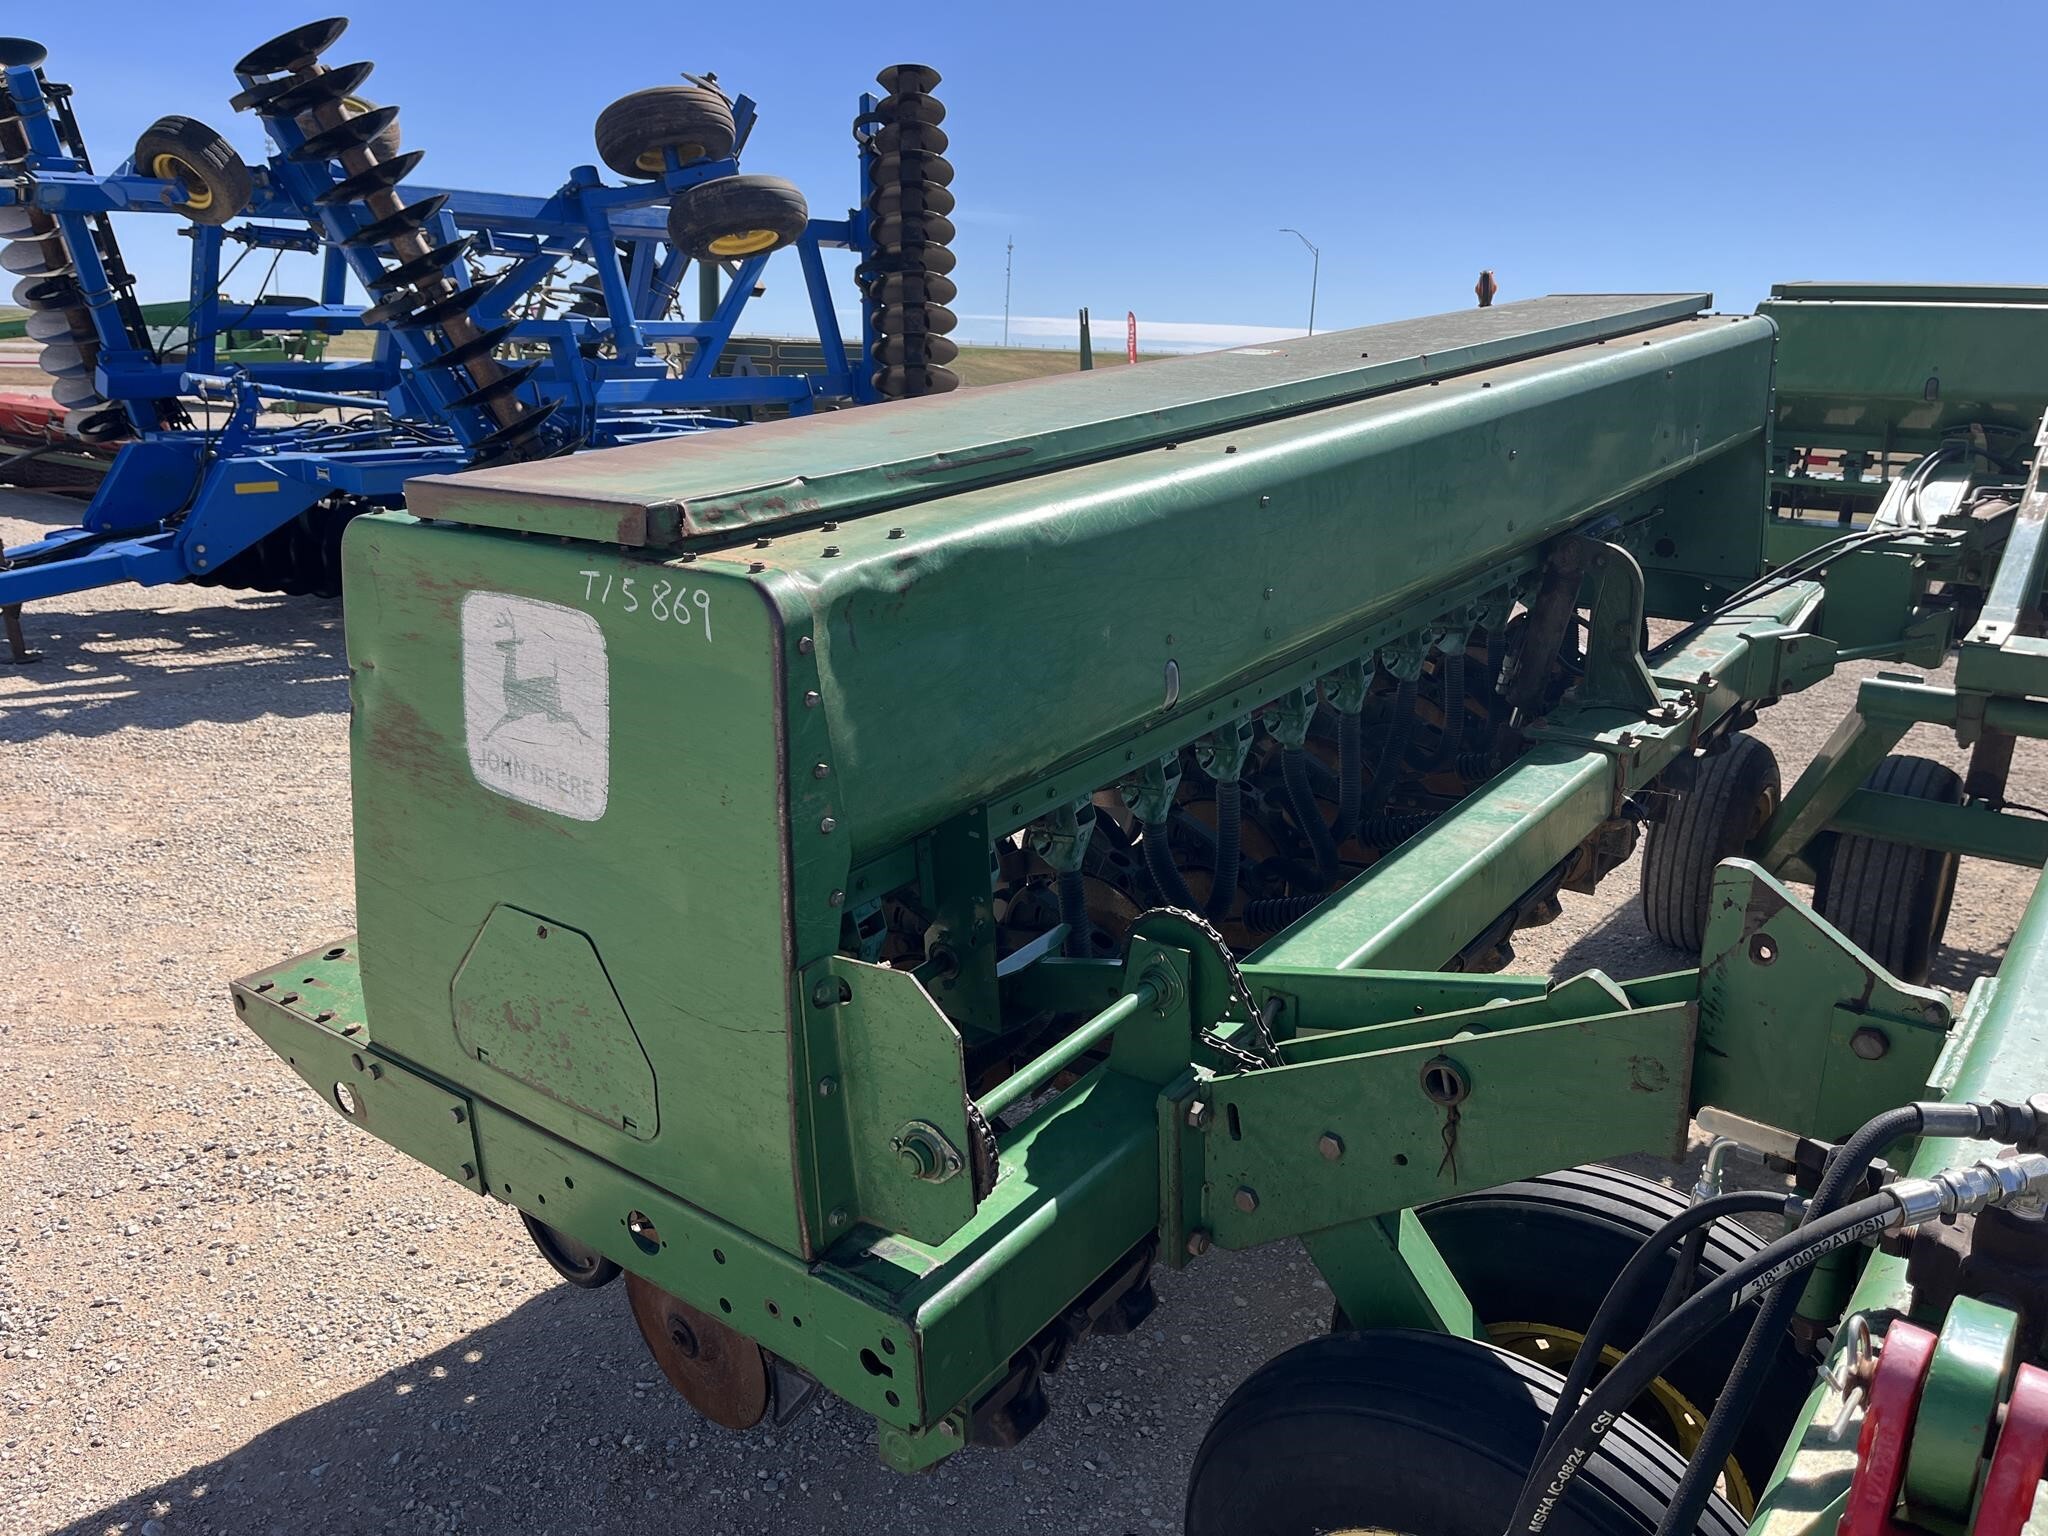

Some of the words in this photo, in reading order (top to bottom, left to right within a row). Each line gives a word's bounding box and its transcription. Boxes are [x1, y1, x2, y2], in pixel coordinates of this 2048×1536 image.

[478, 749, 528, 783] JOHN
[531, 764, 595, 801] DEERE
[1751, 1268, 1781, 1292] 3/8"
[1528, 1497, 1554, 1533] MSHA
[1547, 1447, 1586, 1496] IC-08/24
[1590, 1410, 1616, 1435] CSI
